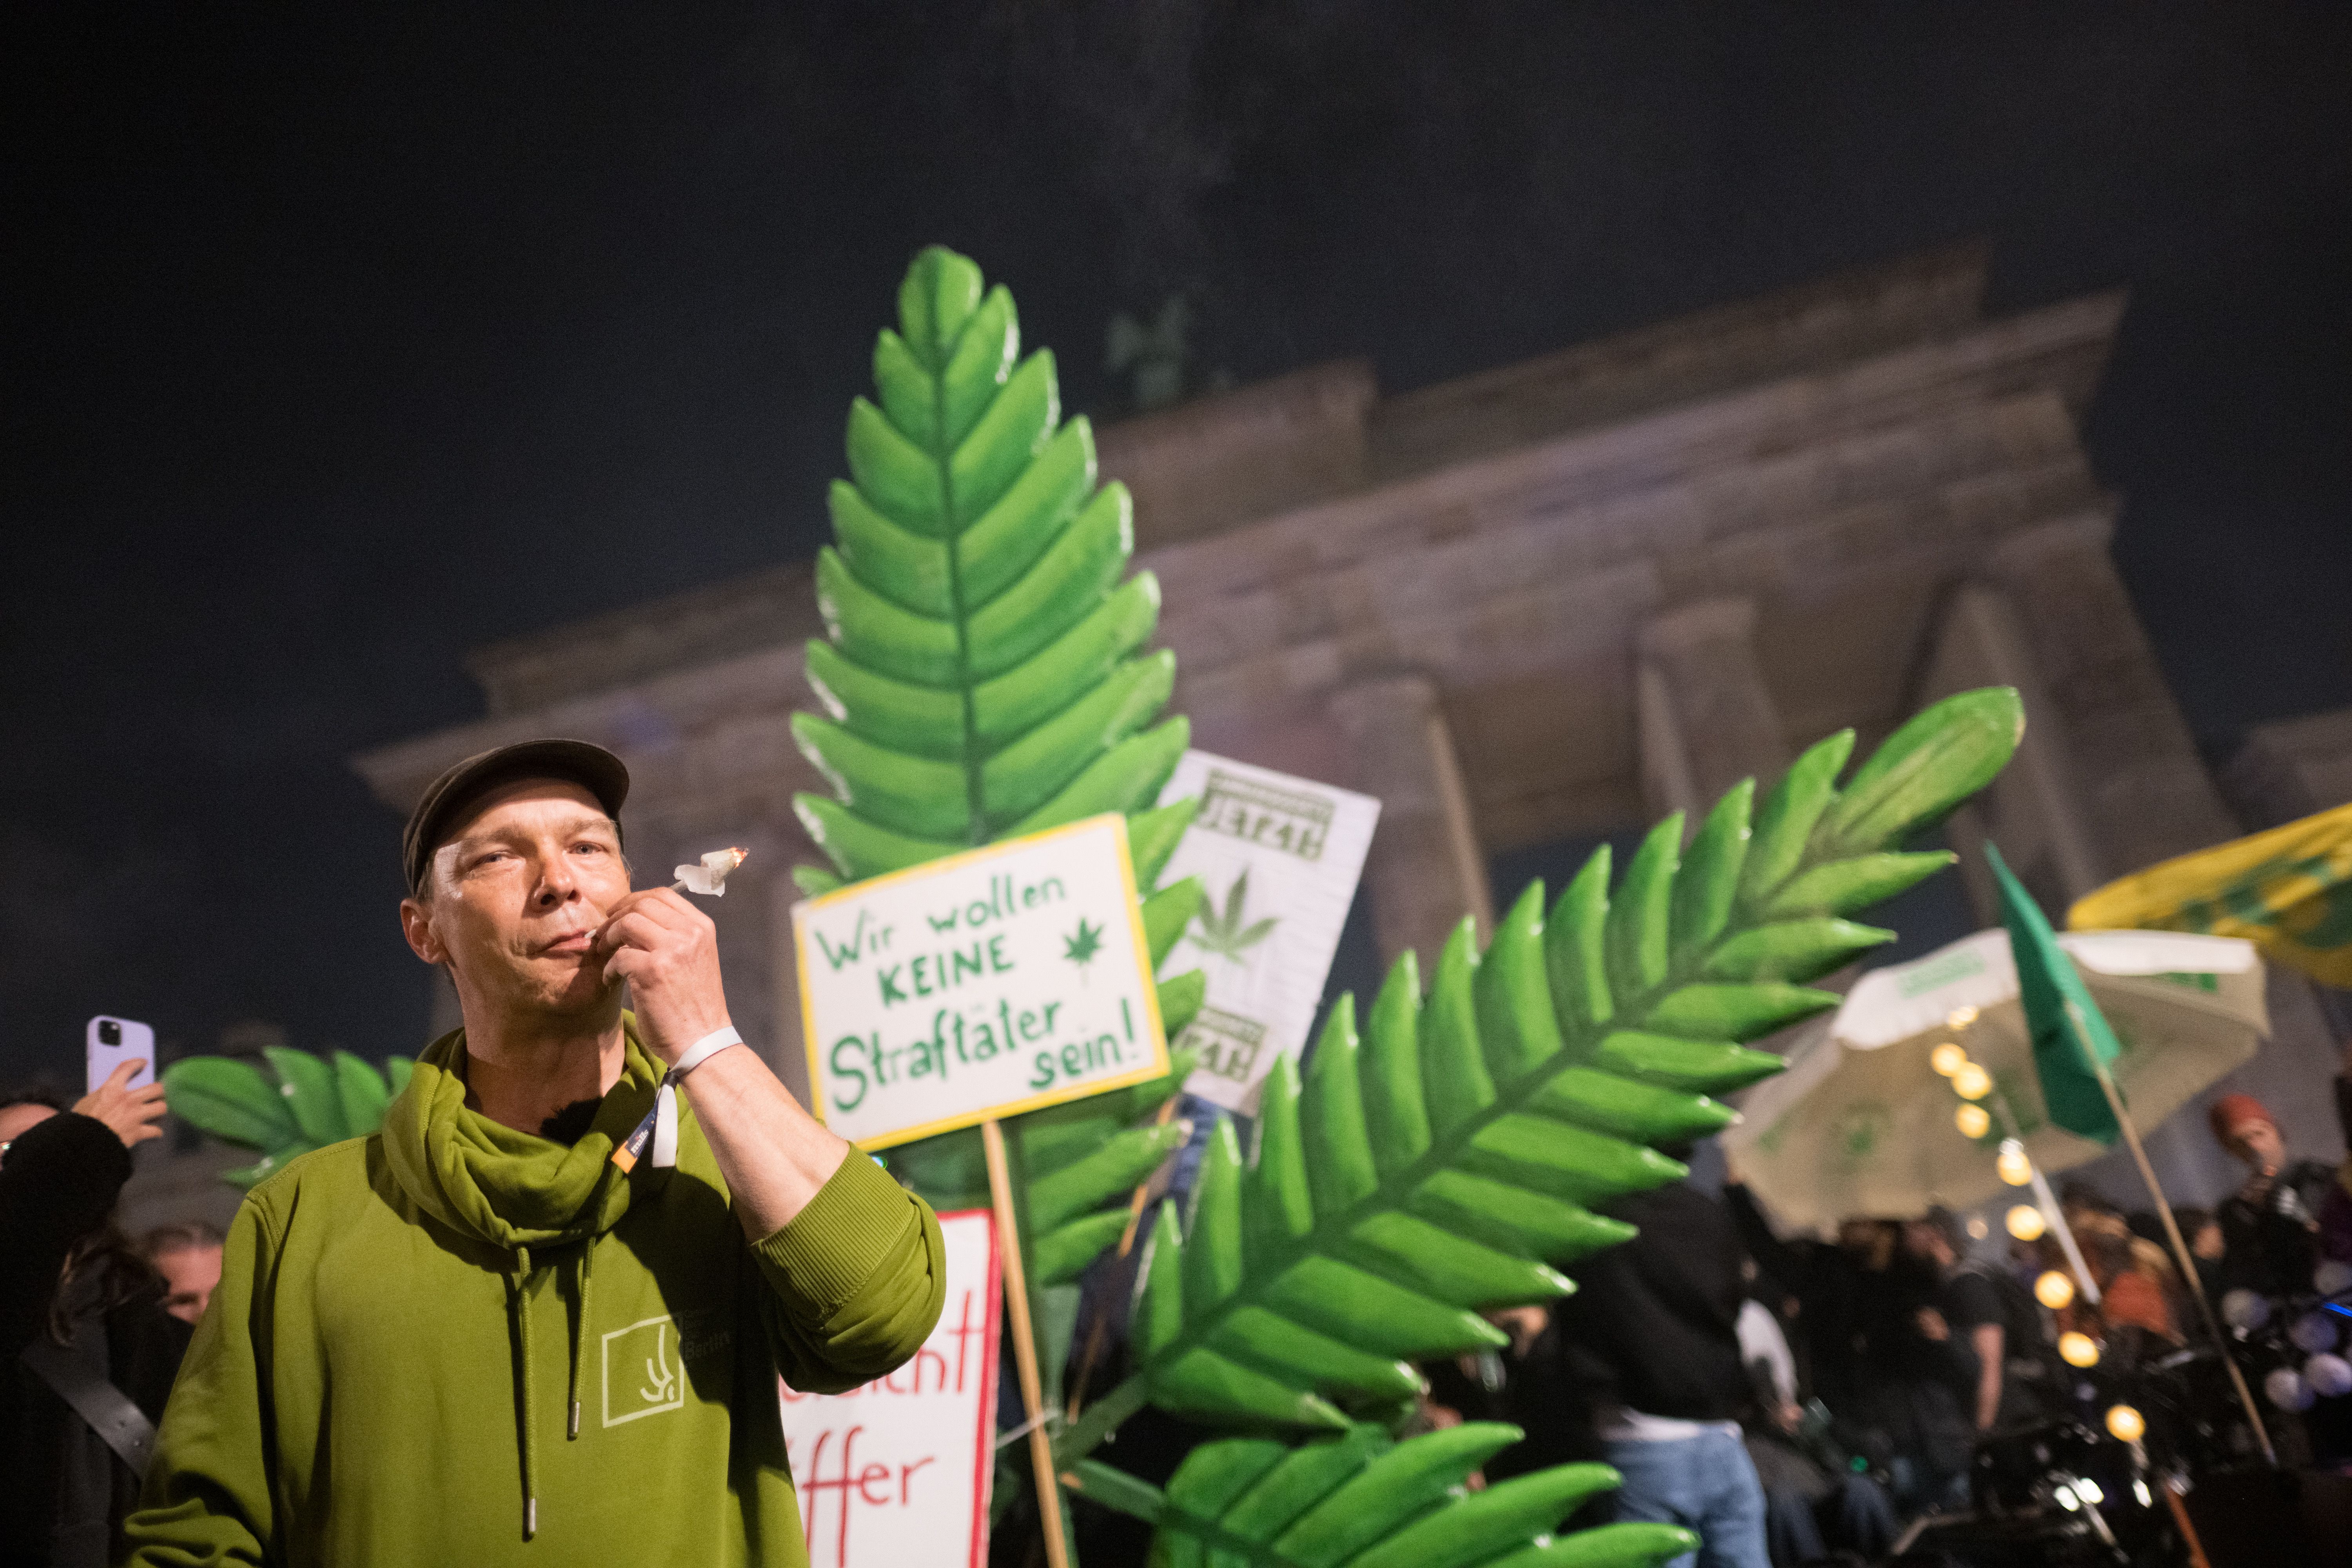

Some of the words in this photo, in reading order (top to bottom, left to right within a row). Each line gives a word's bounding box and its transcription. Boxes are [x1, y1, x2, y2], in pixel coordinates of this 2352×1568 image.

[815, 909, 895, 971] Wir
[927, 875, 1065, 934] wollen
[877, 935, 1015, 1007] KEINE
[829, 998, 1061, 1113] Straftäter
[1029, 997, 1138, 1090] sein!
[785, 1424, 936, 1568] ffer
